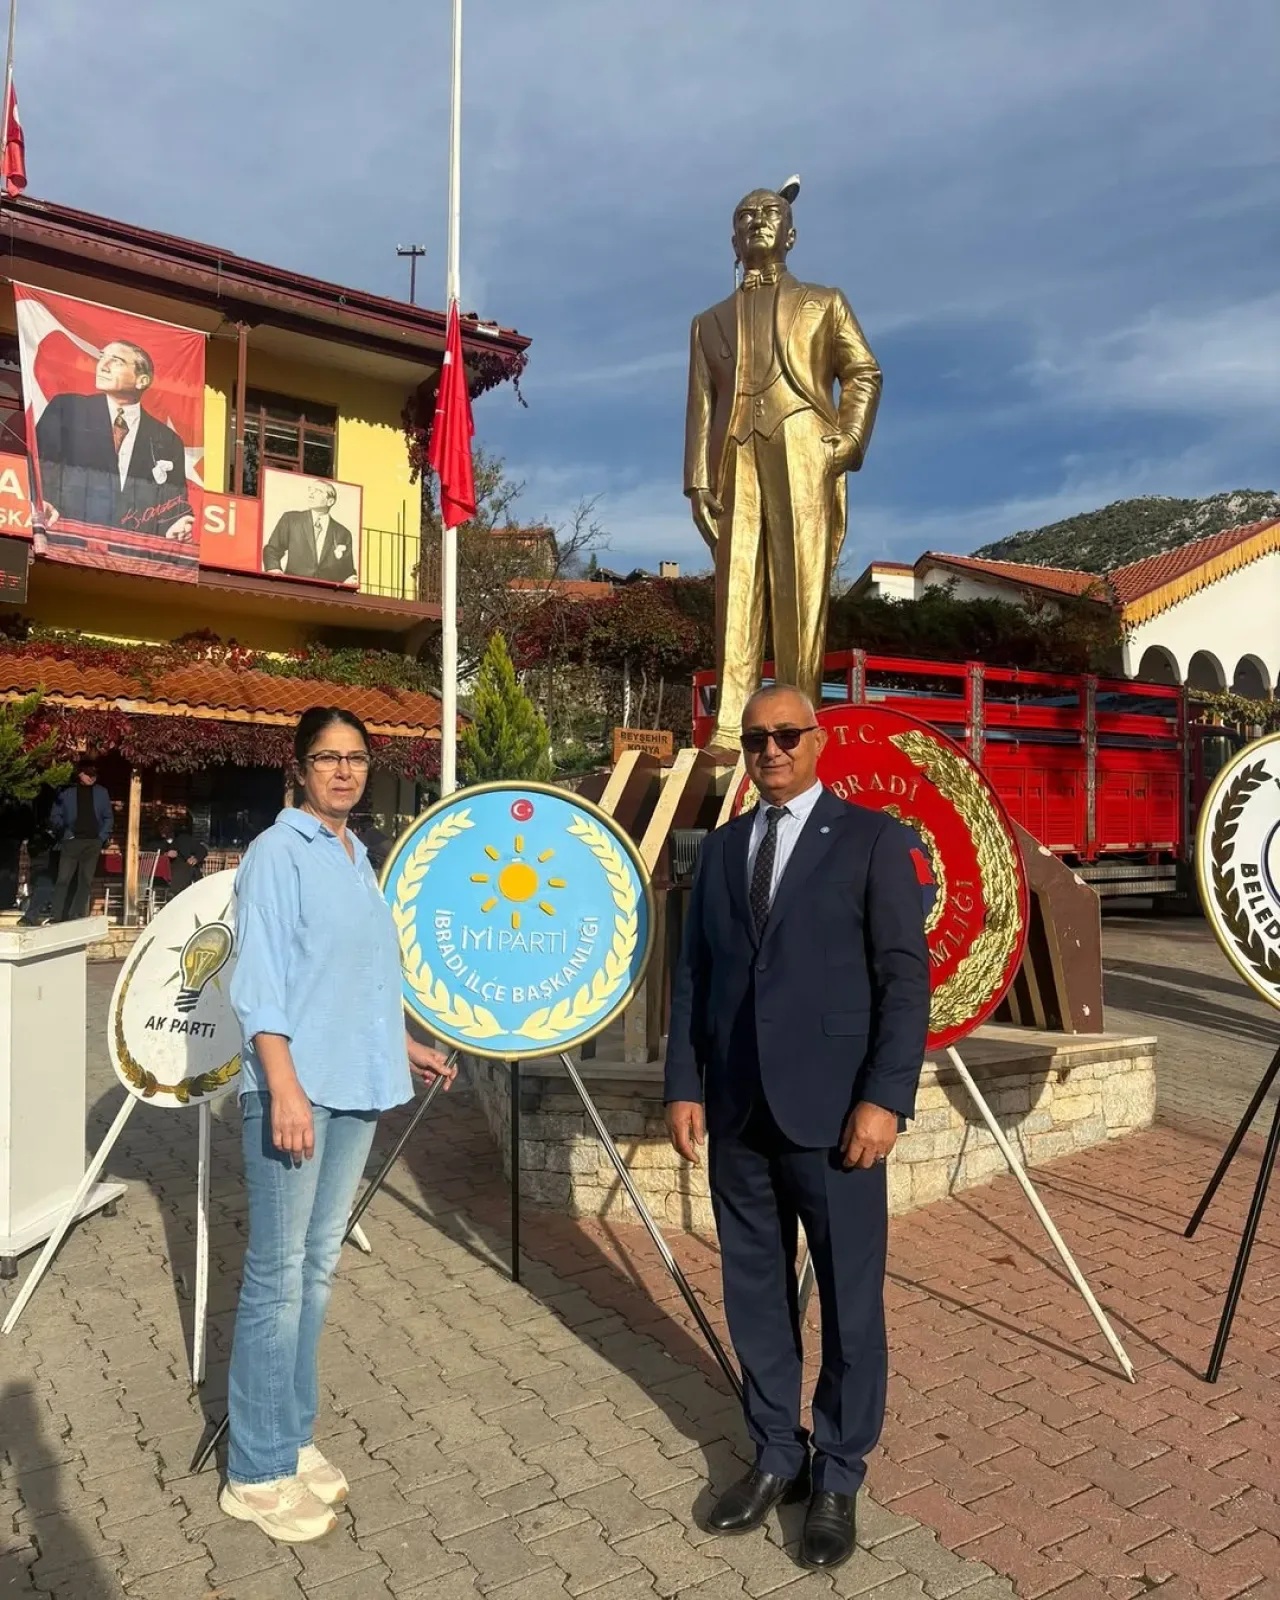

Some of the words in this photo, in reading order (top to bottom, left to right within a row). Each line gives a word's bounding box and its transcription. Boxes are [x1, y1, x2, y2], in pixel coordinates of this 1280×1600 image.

[833, 723, 883, 745] T.C.
[627, 744, 660, 755] KONYA
[831, 771, 919, 802] BRADI
[1240, 863, 1280, 951] BELED
[461, 925, 493, 951] İYİ
[498, 929, 567, 954] PARTİ
[512, 917, 600, 1003] BAŞKANLIĞI
[144, 1015, 168, 1031] AK
